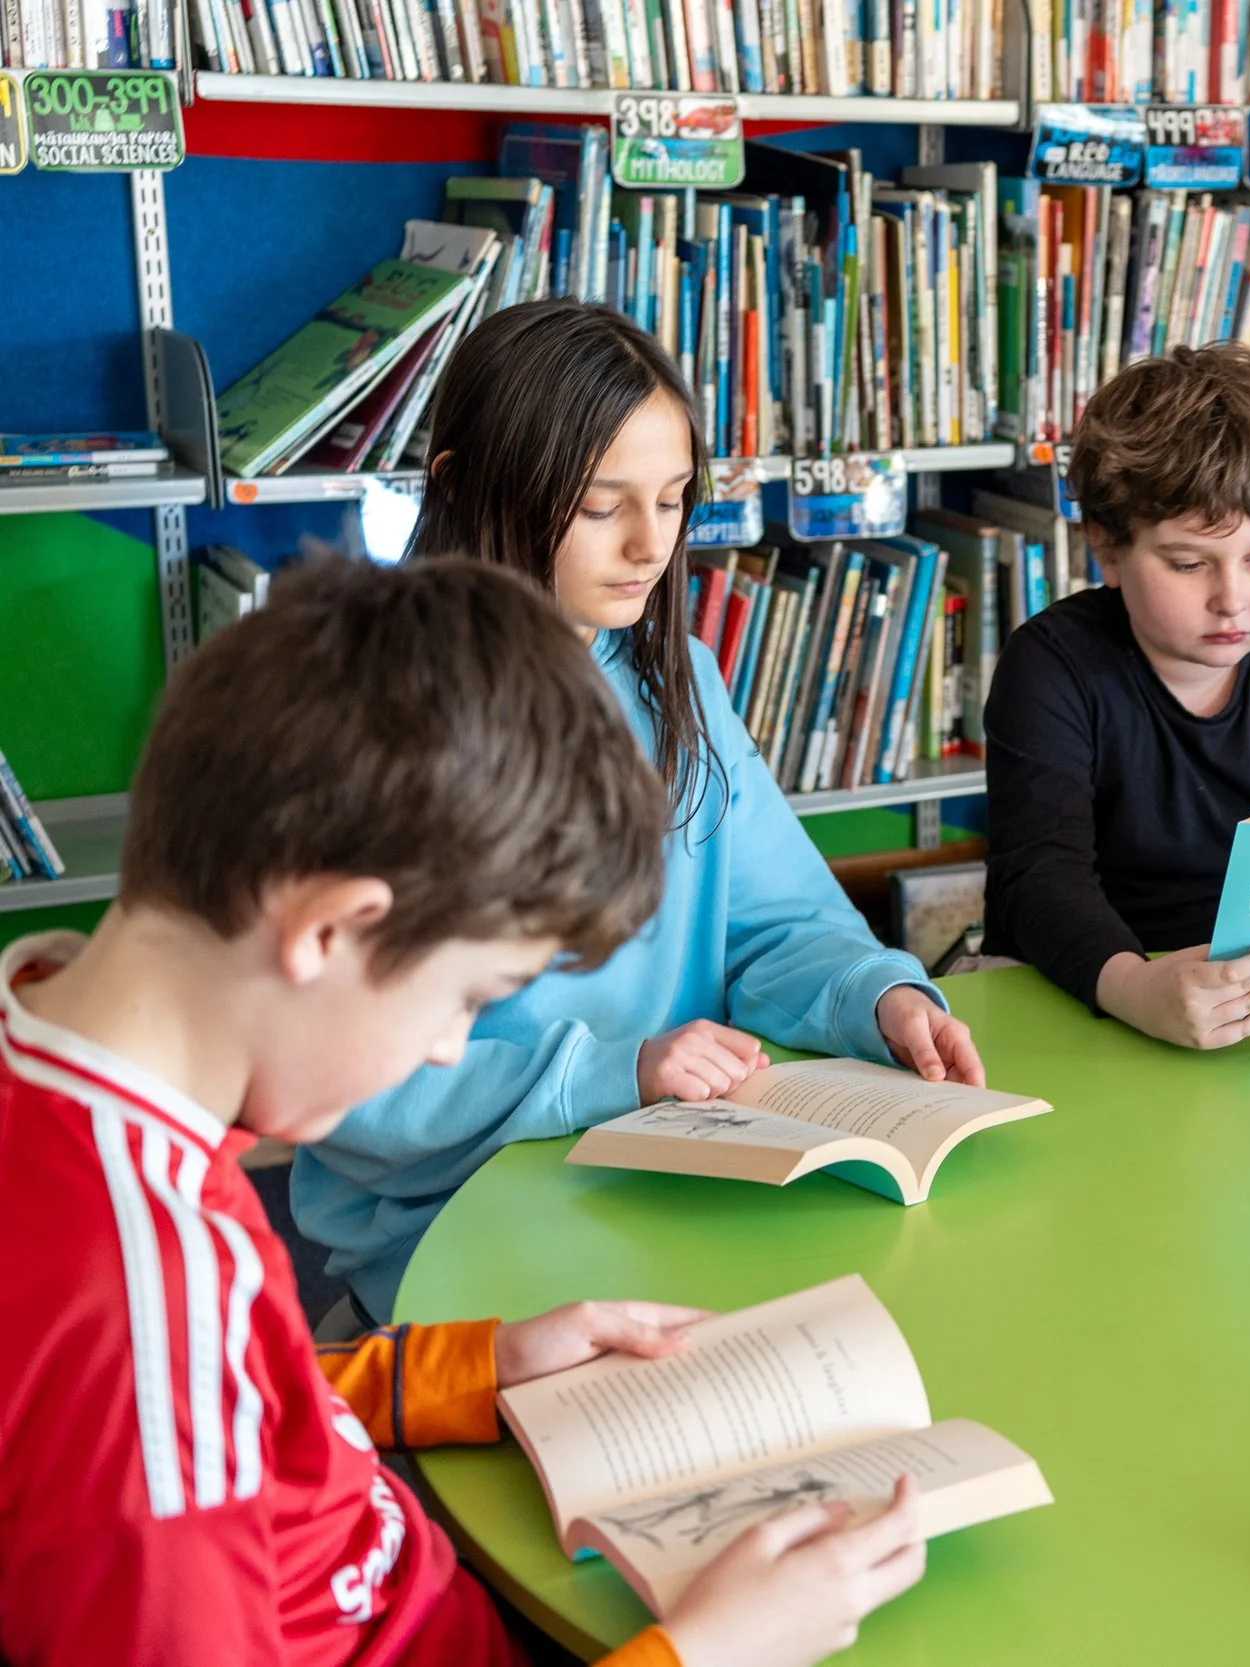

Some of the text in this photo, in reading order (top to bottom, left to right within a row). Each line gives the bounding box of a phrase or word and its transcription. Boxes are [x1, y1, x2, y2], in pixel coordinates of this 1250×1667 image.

[31, 77, 168, 115] 300-399
[620, 98, 677, 137] 398
[1148, 110, 1196, 146] 499
[37, 144, 179, 166] SOCIAL SCIENCES
[630, 158, 727, 181] MYTHOLOGY
[1045, 162, 1124, 181] LANGUAGE
[794, 458, 846, 495] 598
